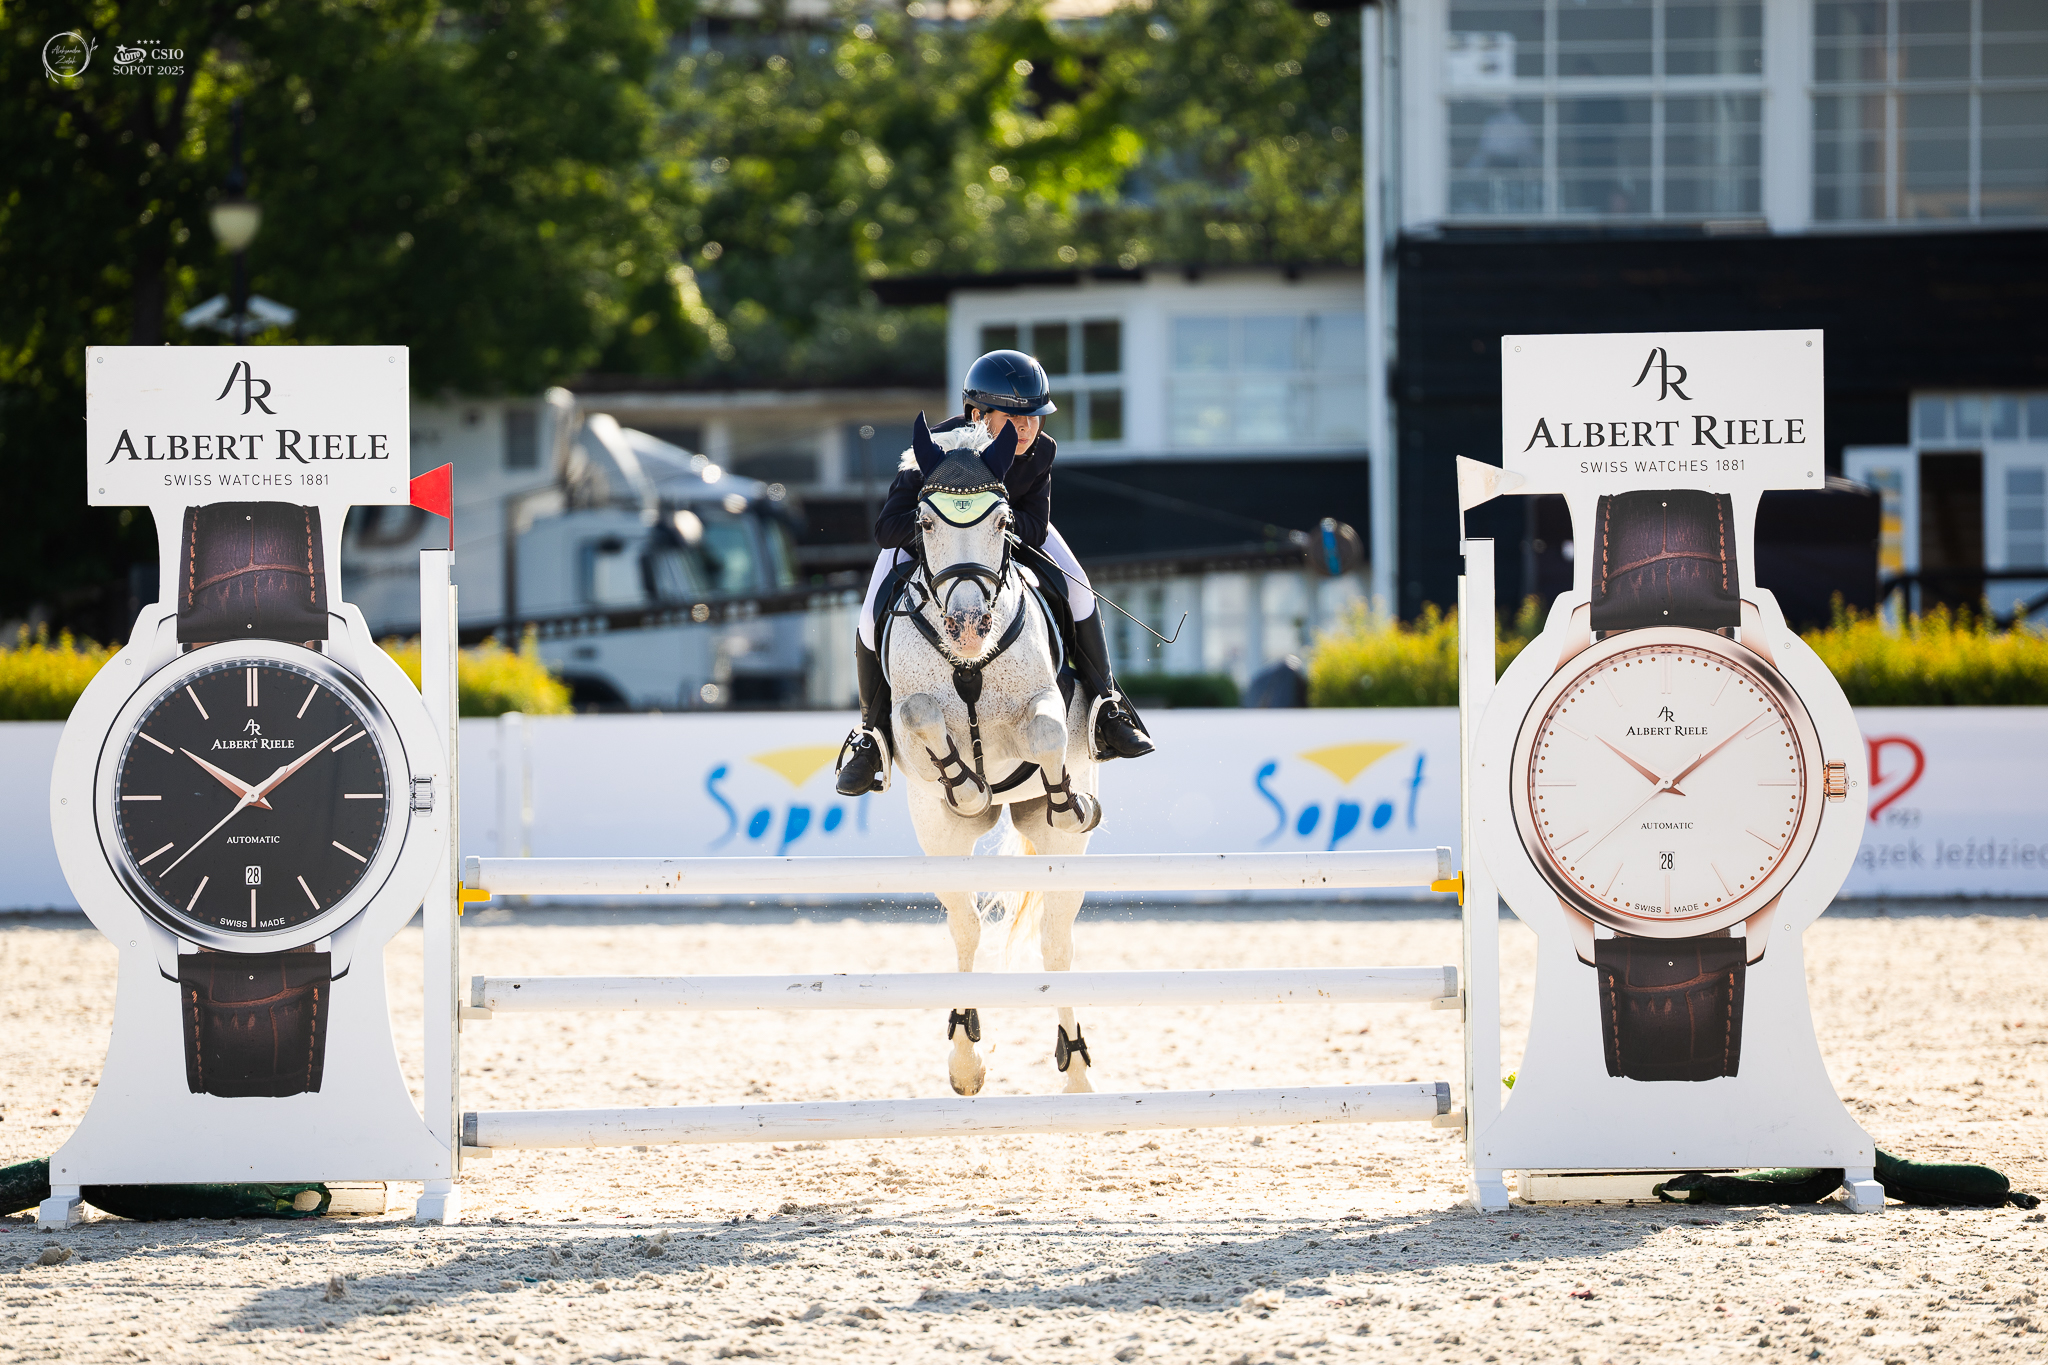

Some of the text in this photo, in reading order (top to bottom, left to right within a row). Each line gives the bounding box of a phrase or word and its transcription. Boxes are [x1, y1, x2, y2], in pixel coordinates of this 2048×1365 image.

[1522, 414, 1807, 453] ALBERT RIELE
[104, 428, 390, 465] ALBERT RIELE
[1580, 458, 1745, 474] SWISS WATCHES 1881
[164, 473, 329, 487] SWISS WATCHES 1881
[1625, 725, 1709, 737] ALBERT RIELE
[210, 737, 295, 751] ALBERT RIELE
[1254, 751, 1428, 852] Sopot
[1640, 821, 1694, 830] AUTOMATIC
[226, 835, 281, 844] AUTOMATIC
[1660, 853, 1674, 870] 28
[1858, 836, 1926, 873] ązek
[246, 867, 260, 884] 28
[1634, 903, 1700, 914] SWISS MADE
[219, 917, 286, 928] SWISS MADE
